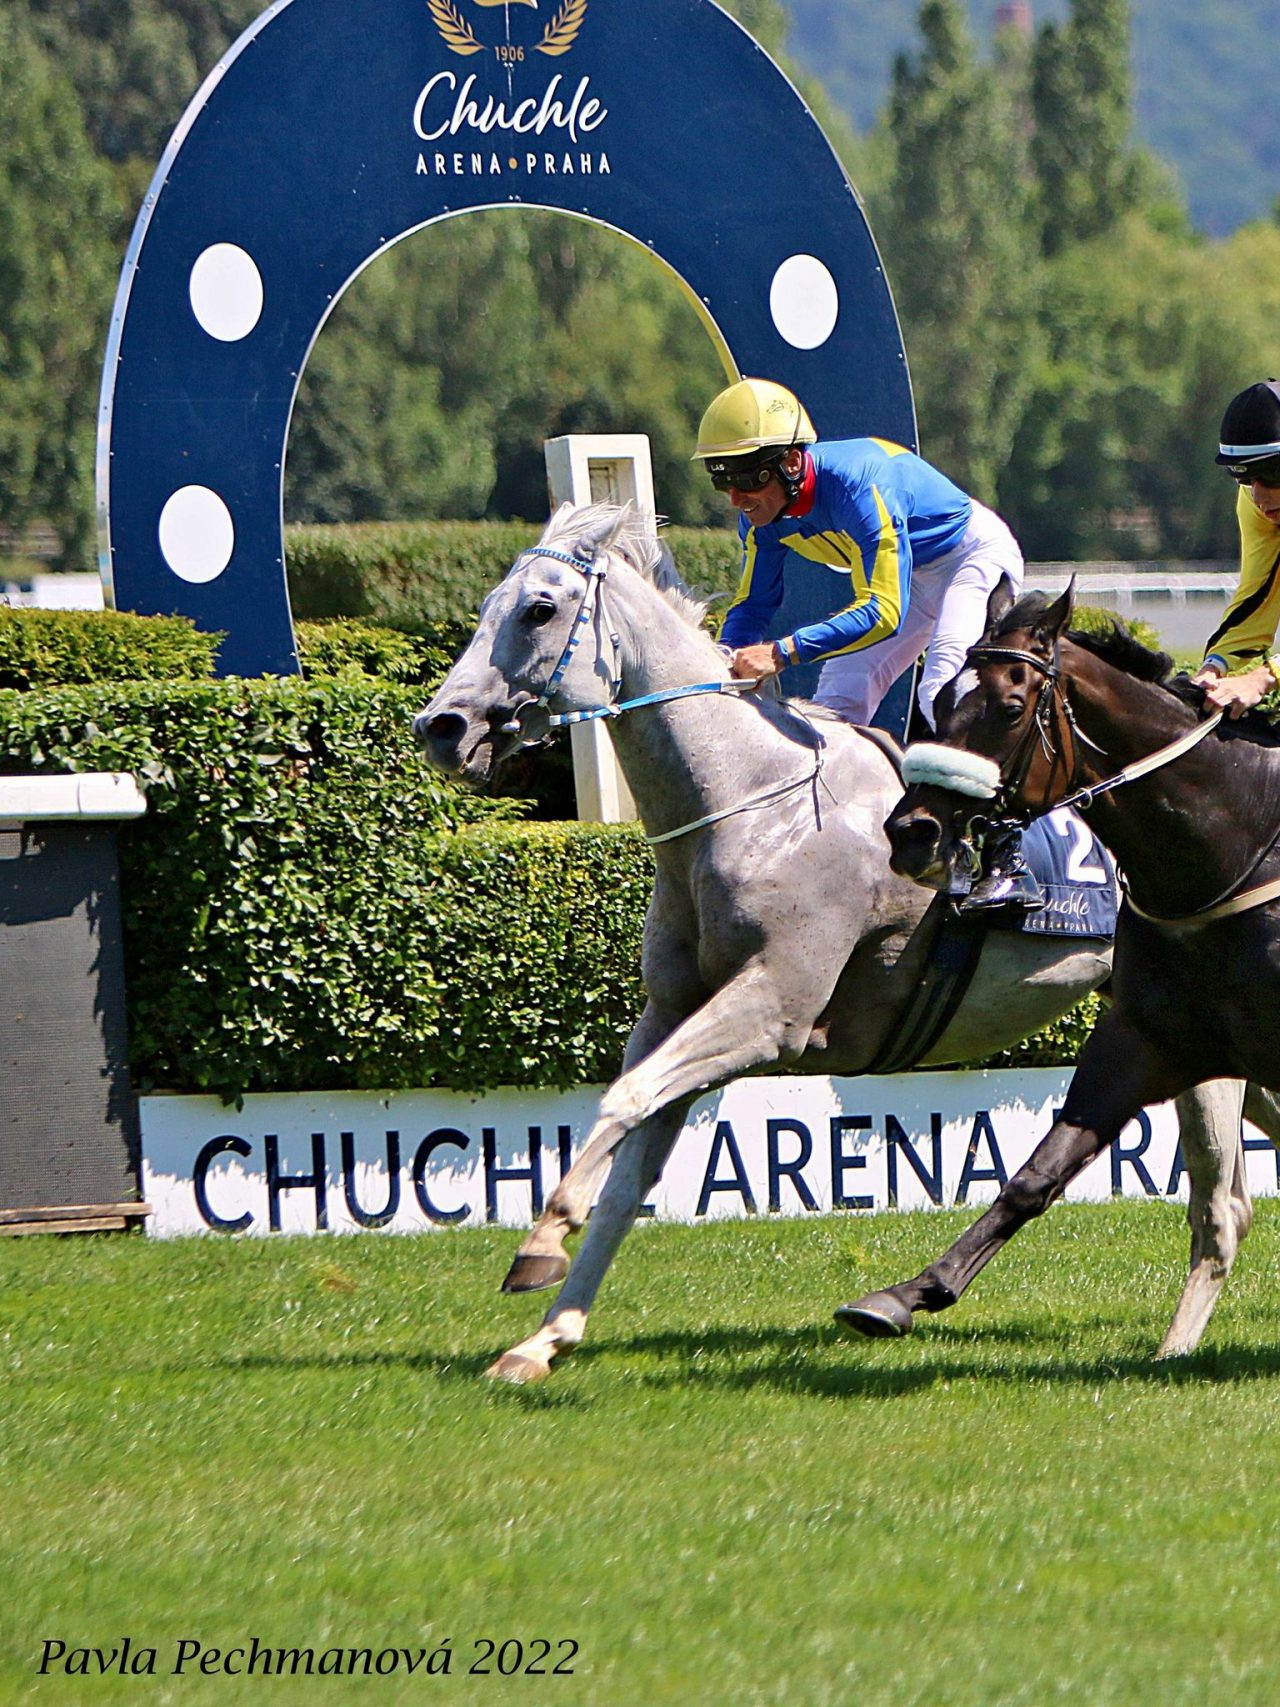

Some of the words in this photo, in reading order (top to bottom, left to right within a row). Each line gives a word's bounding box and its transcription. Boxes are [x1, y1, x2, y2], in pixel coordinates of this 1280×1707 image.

[494, 46, 525, 62] 1906
[413, 71, 608, 143] Chuchle
[416, 153, 501, 175] ARENA
[526, 153, 611, 175] PRAHA
[1049, 805, 1107, 884] 2
[695, 1111, 1008, 1216] ARENA
